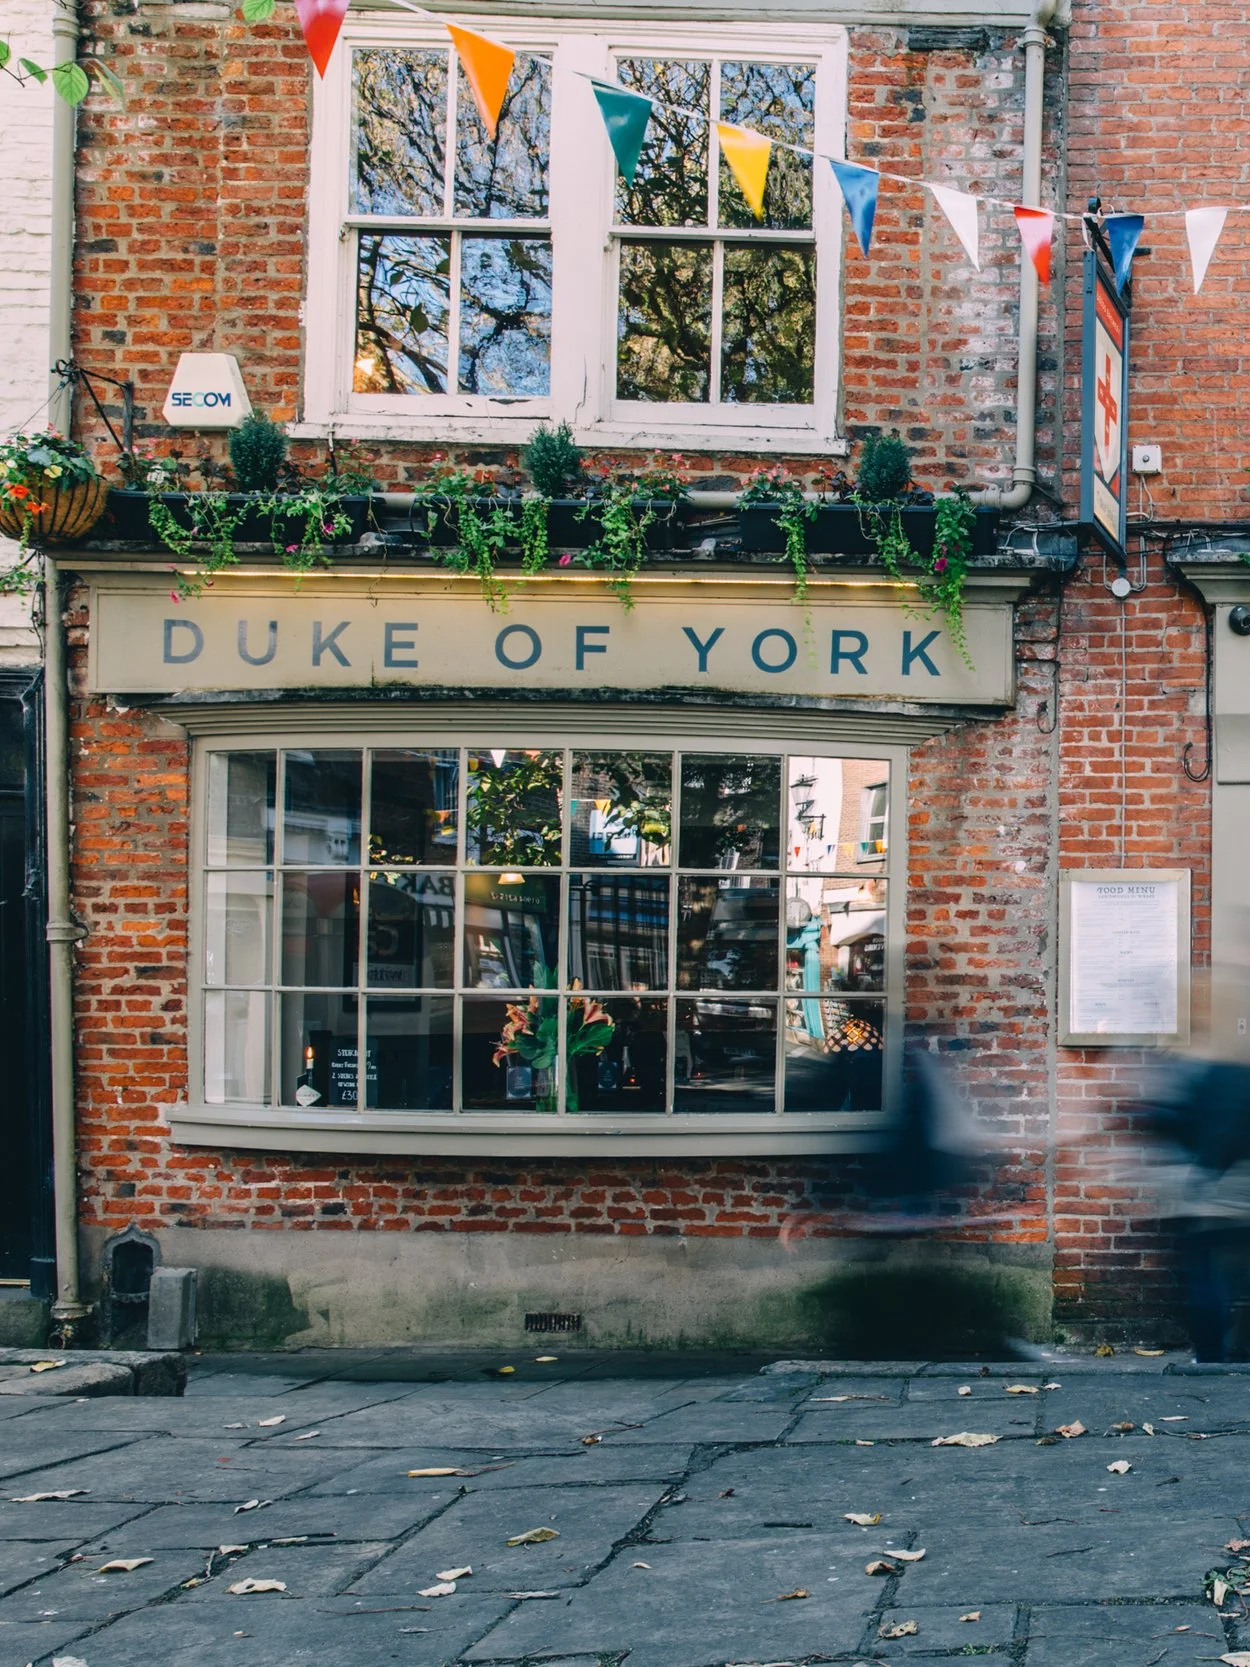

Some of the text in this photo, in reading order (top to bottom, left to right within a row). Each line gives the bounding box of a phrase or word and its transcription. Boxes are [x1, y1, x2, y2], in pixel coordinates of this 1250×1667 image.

[171, 392, 231, 407] SECOM
[163, 618, 943, 677] DUKE OF YORK
[1096, 886, 1156, 894] FOOD MENU
